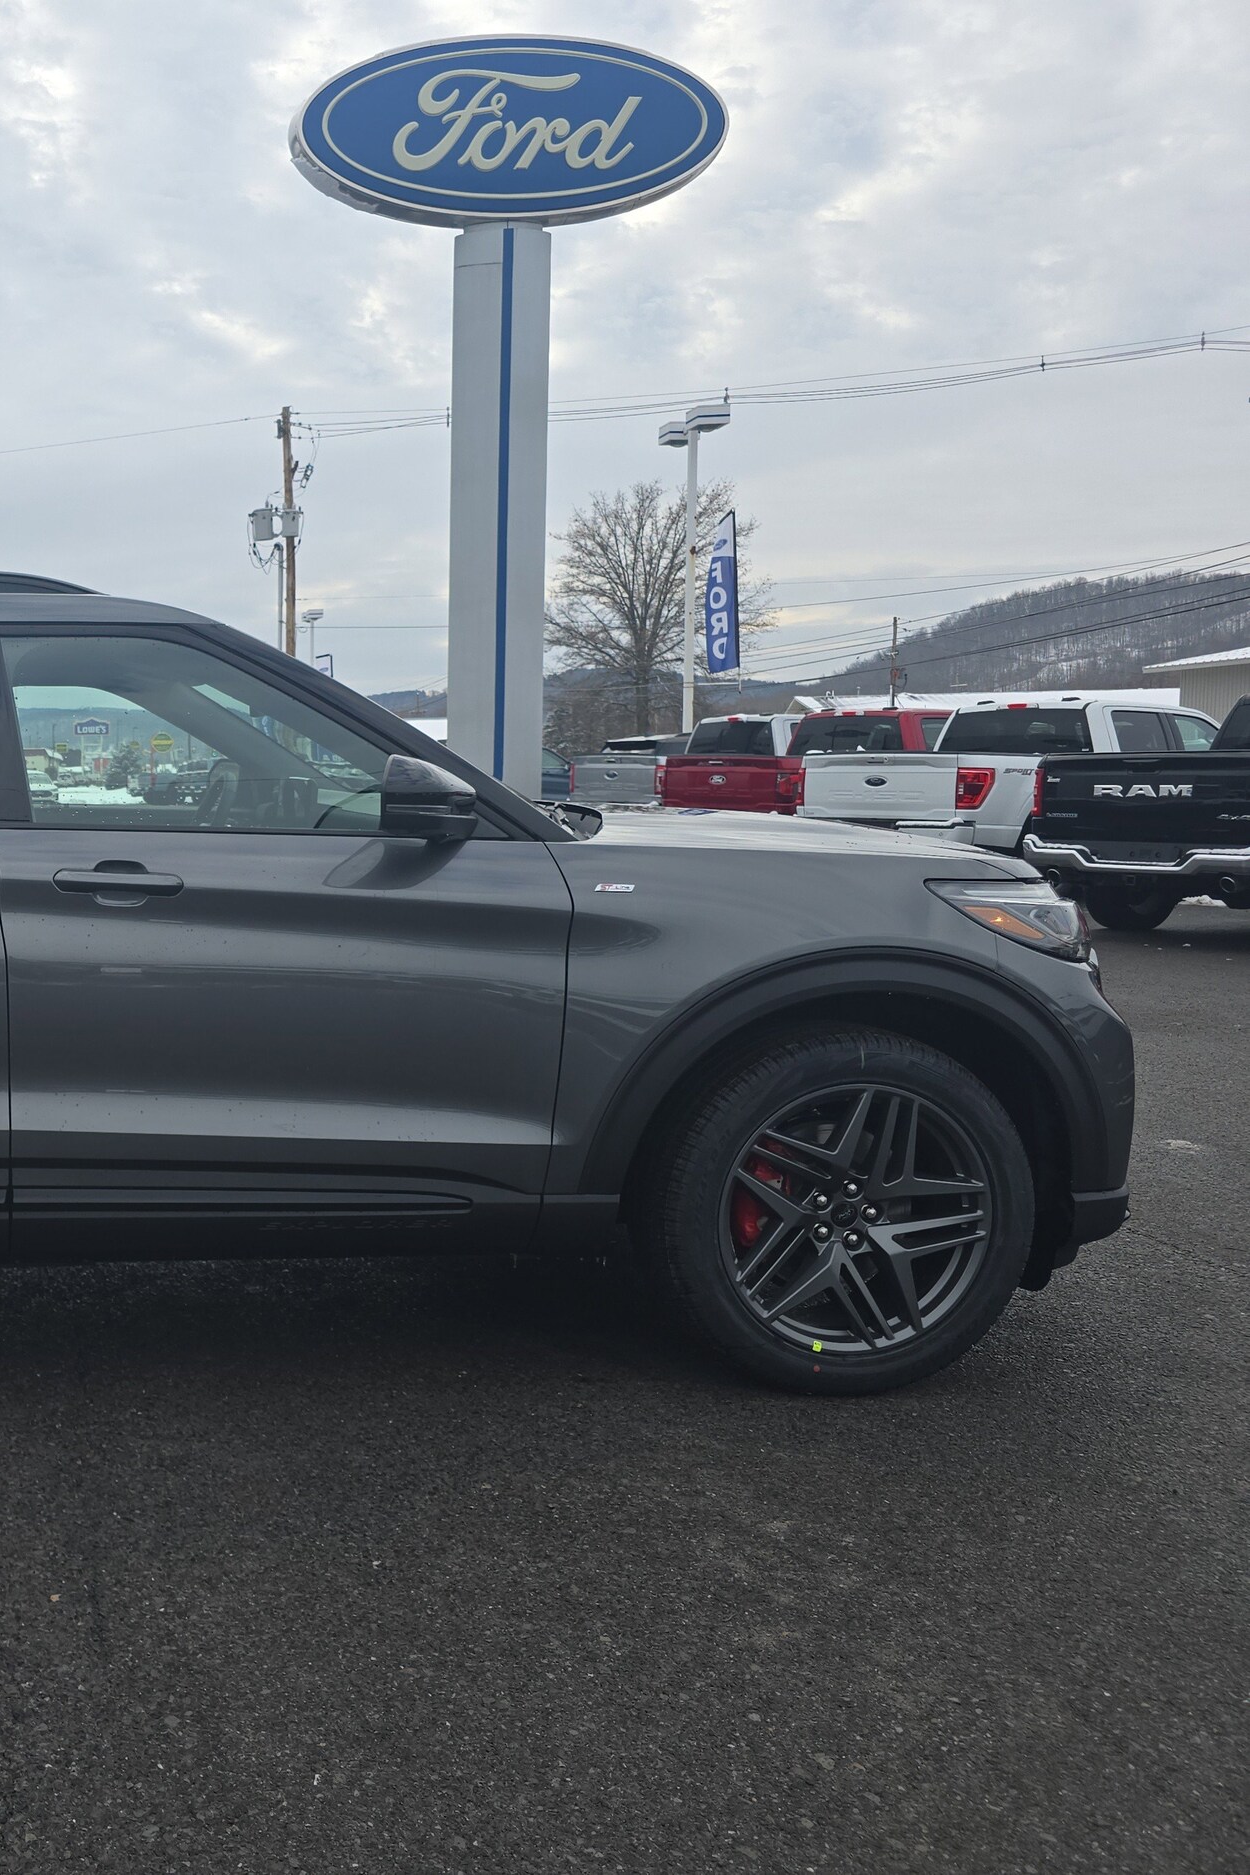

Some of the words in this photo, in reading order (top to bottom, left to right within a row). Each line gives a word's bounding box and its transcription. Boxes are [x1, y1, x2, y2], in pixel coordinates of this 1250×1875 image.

[393, 69, 643, 171] Ford
[77, 725, 107, 734] LOWE'S
[1093, 785, 1193, 798] RAM
